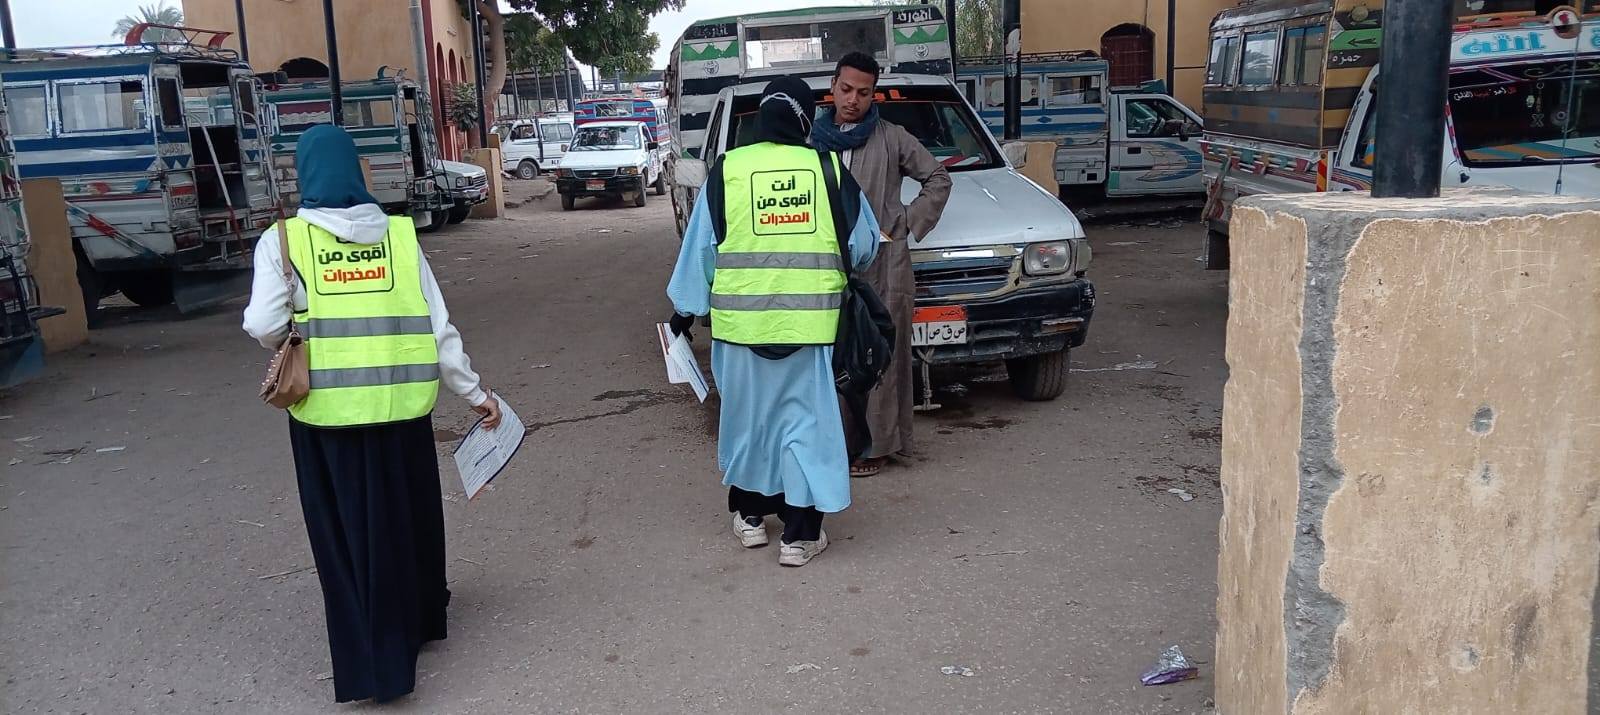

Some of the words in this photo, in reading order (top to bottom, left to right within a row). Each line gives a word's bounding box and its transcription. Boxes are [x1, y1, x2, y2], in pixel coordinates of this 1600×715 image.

[757, 195, 777, 210] من
[759, 211, 810, 226] المخدرات
[318, 248, 343, 265] من
[323, 266, 386, 284] المخدرات
